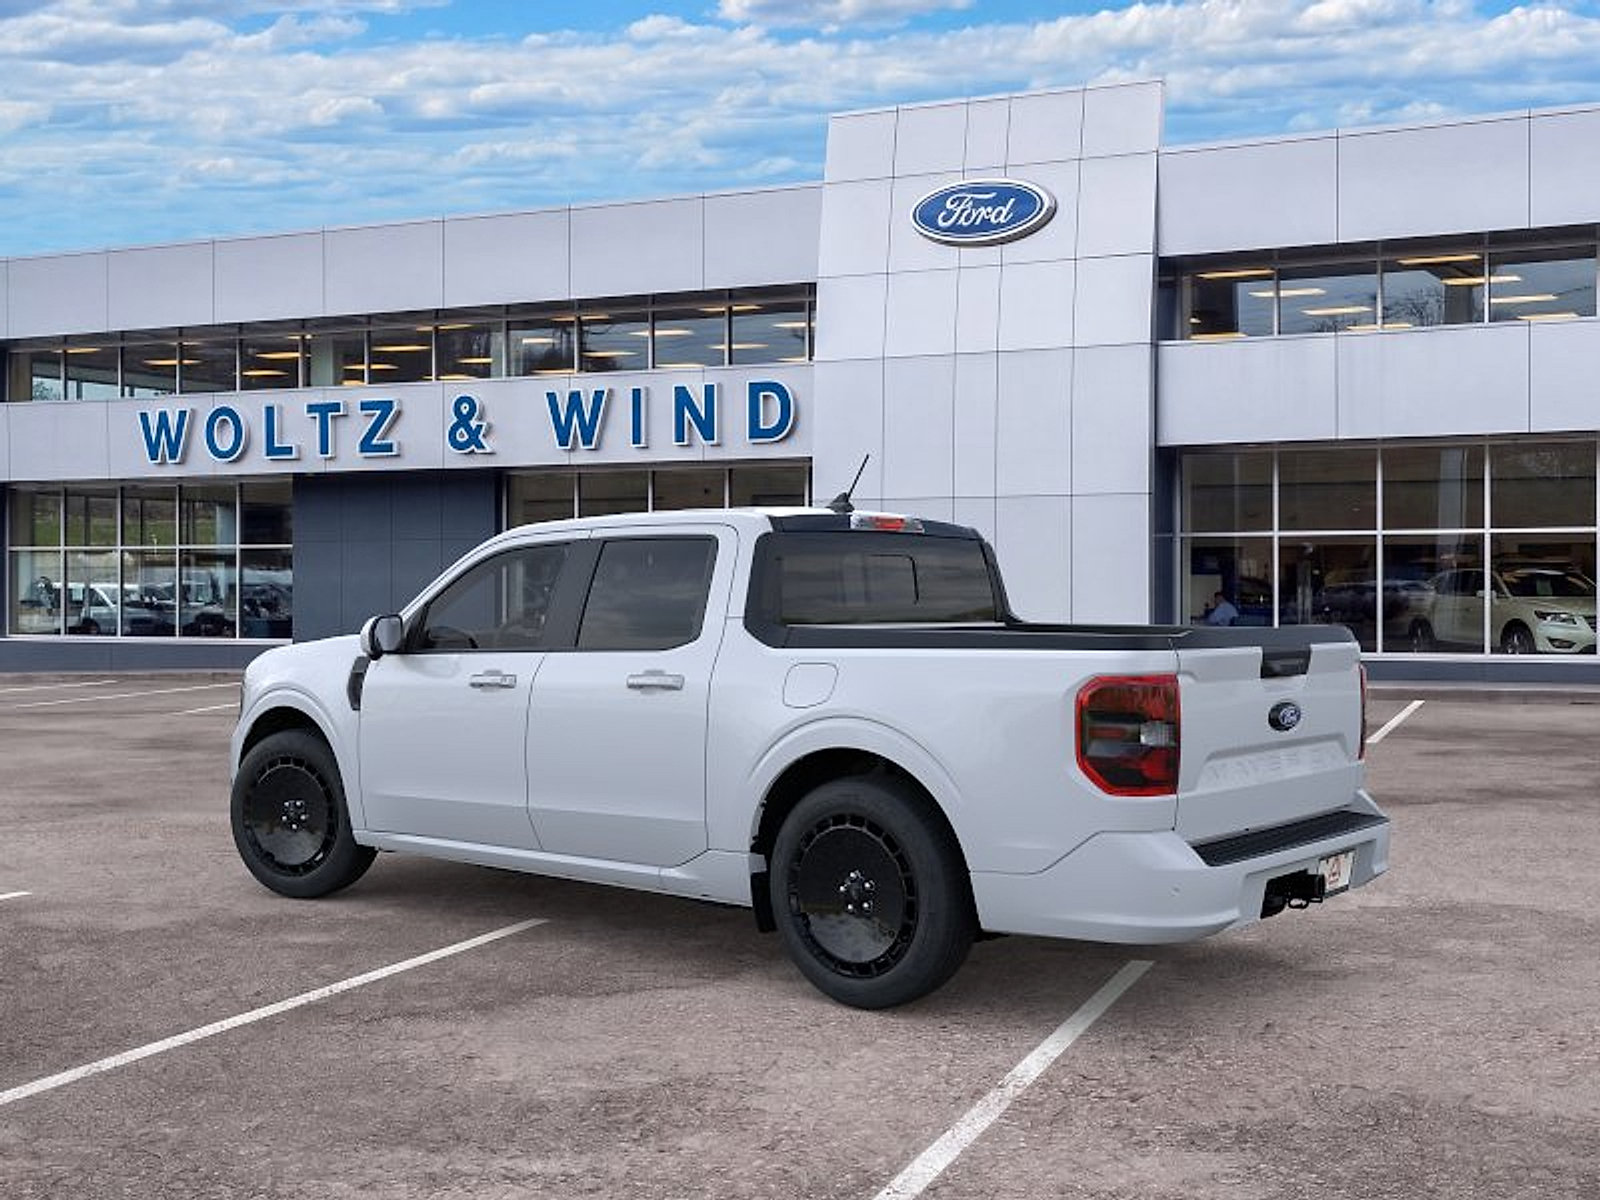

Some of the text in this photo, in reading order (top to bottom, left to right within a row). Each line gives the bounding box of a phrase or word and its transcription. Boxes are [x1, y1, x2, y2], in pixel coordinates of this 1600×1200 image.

[937, 192, 1015, 227] Ford
[138, 380, 795, 464] WOLTZ & WIND
